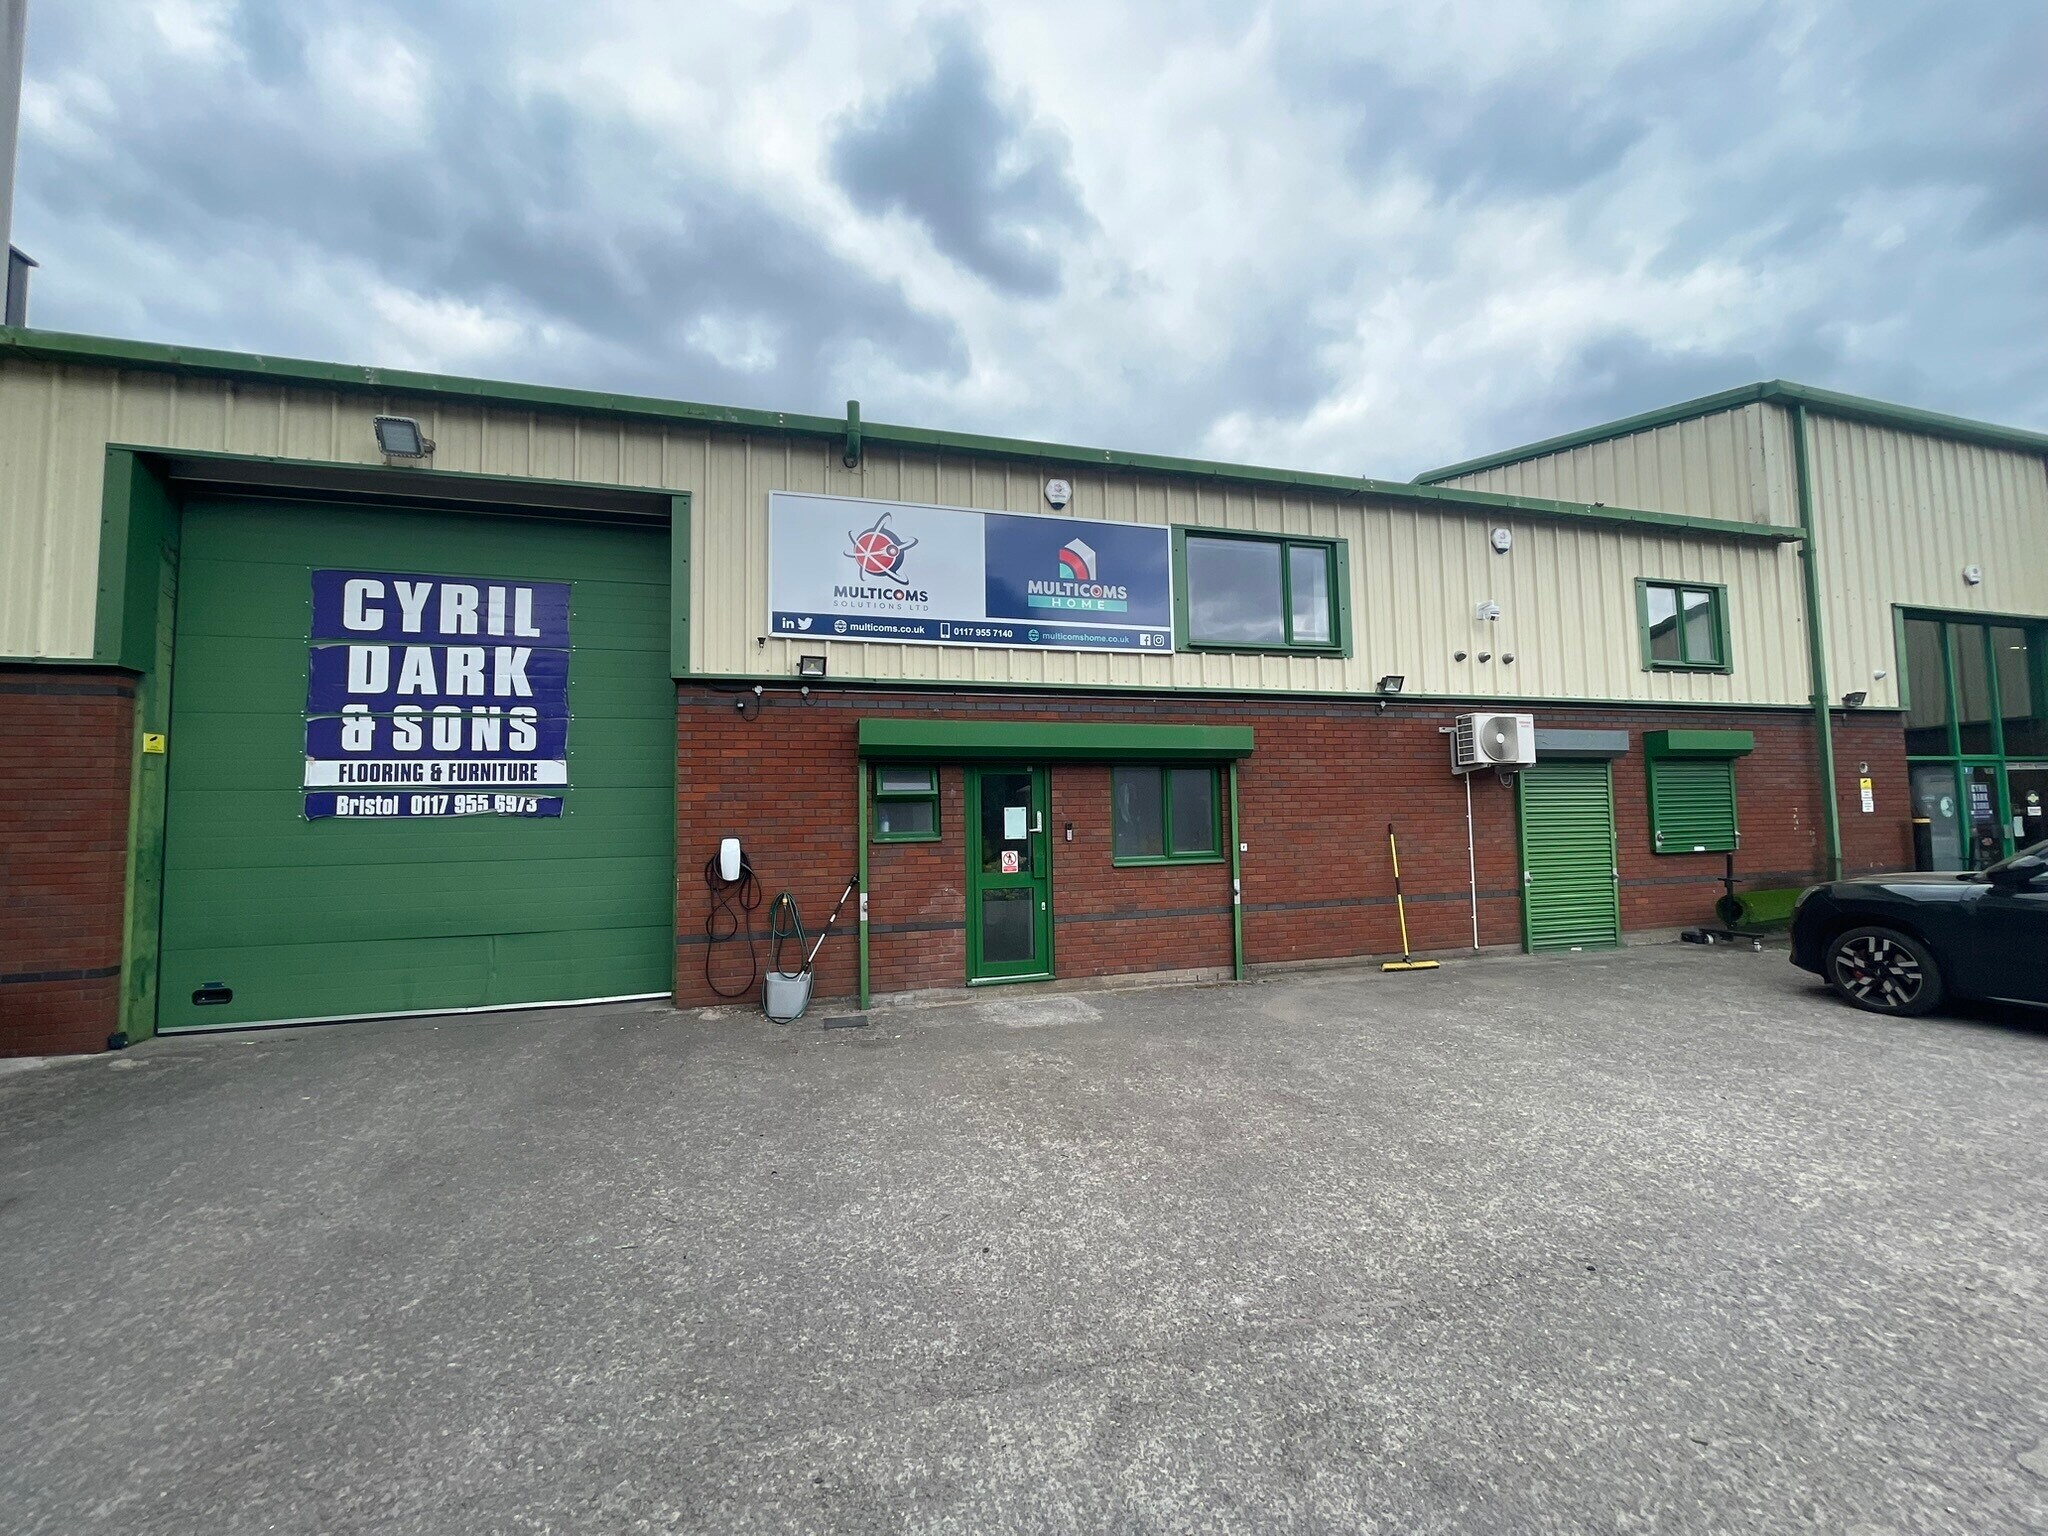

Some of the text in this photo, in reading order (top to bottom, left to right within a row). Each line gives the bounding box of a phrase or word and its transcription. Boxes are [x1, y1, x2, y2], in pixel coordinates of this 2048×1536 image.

[833, 585, 929, 602] MULTICOMS
[1027, 580, 1127, 600] MULTICOMS
[343, 578, 541, 637] CYRIL
[833, 600, 929, 612] SOLUTIONS LTD
[1051, 597, 1105, 610] HOME
[849, 622, 925, 634] multicoms.co.uk
[953, 627, 1013, 638] 0117 955 7140
[1042, 631, 1130, 644] multicomshome.co.uk
[347, 645, 533, 697] DARK
[341, 704, 537, 752] & SONS
[338, 763, 538, 783] FLOORING & FURNITURE
[336, 795, 399, 816] Bristol
[410, 795, 449, 815] 0117
[454, 795, 489, 814] 955
